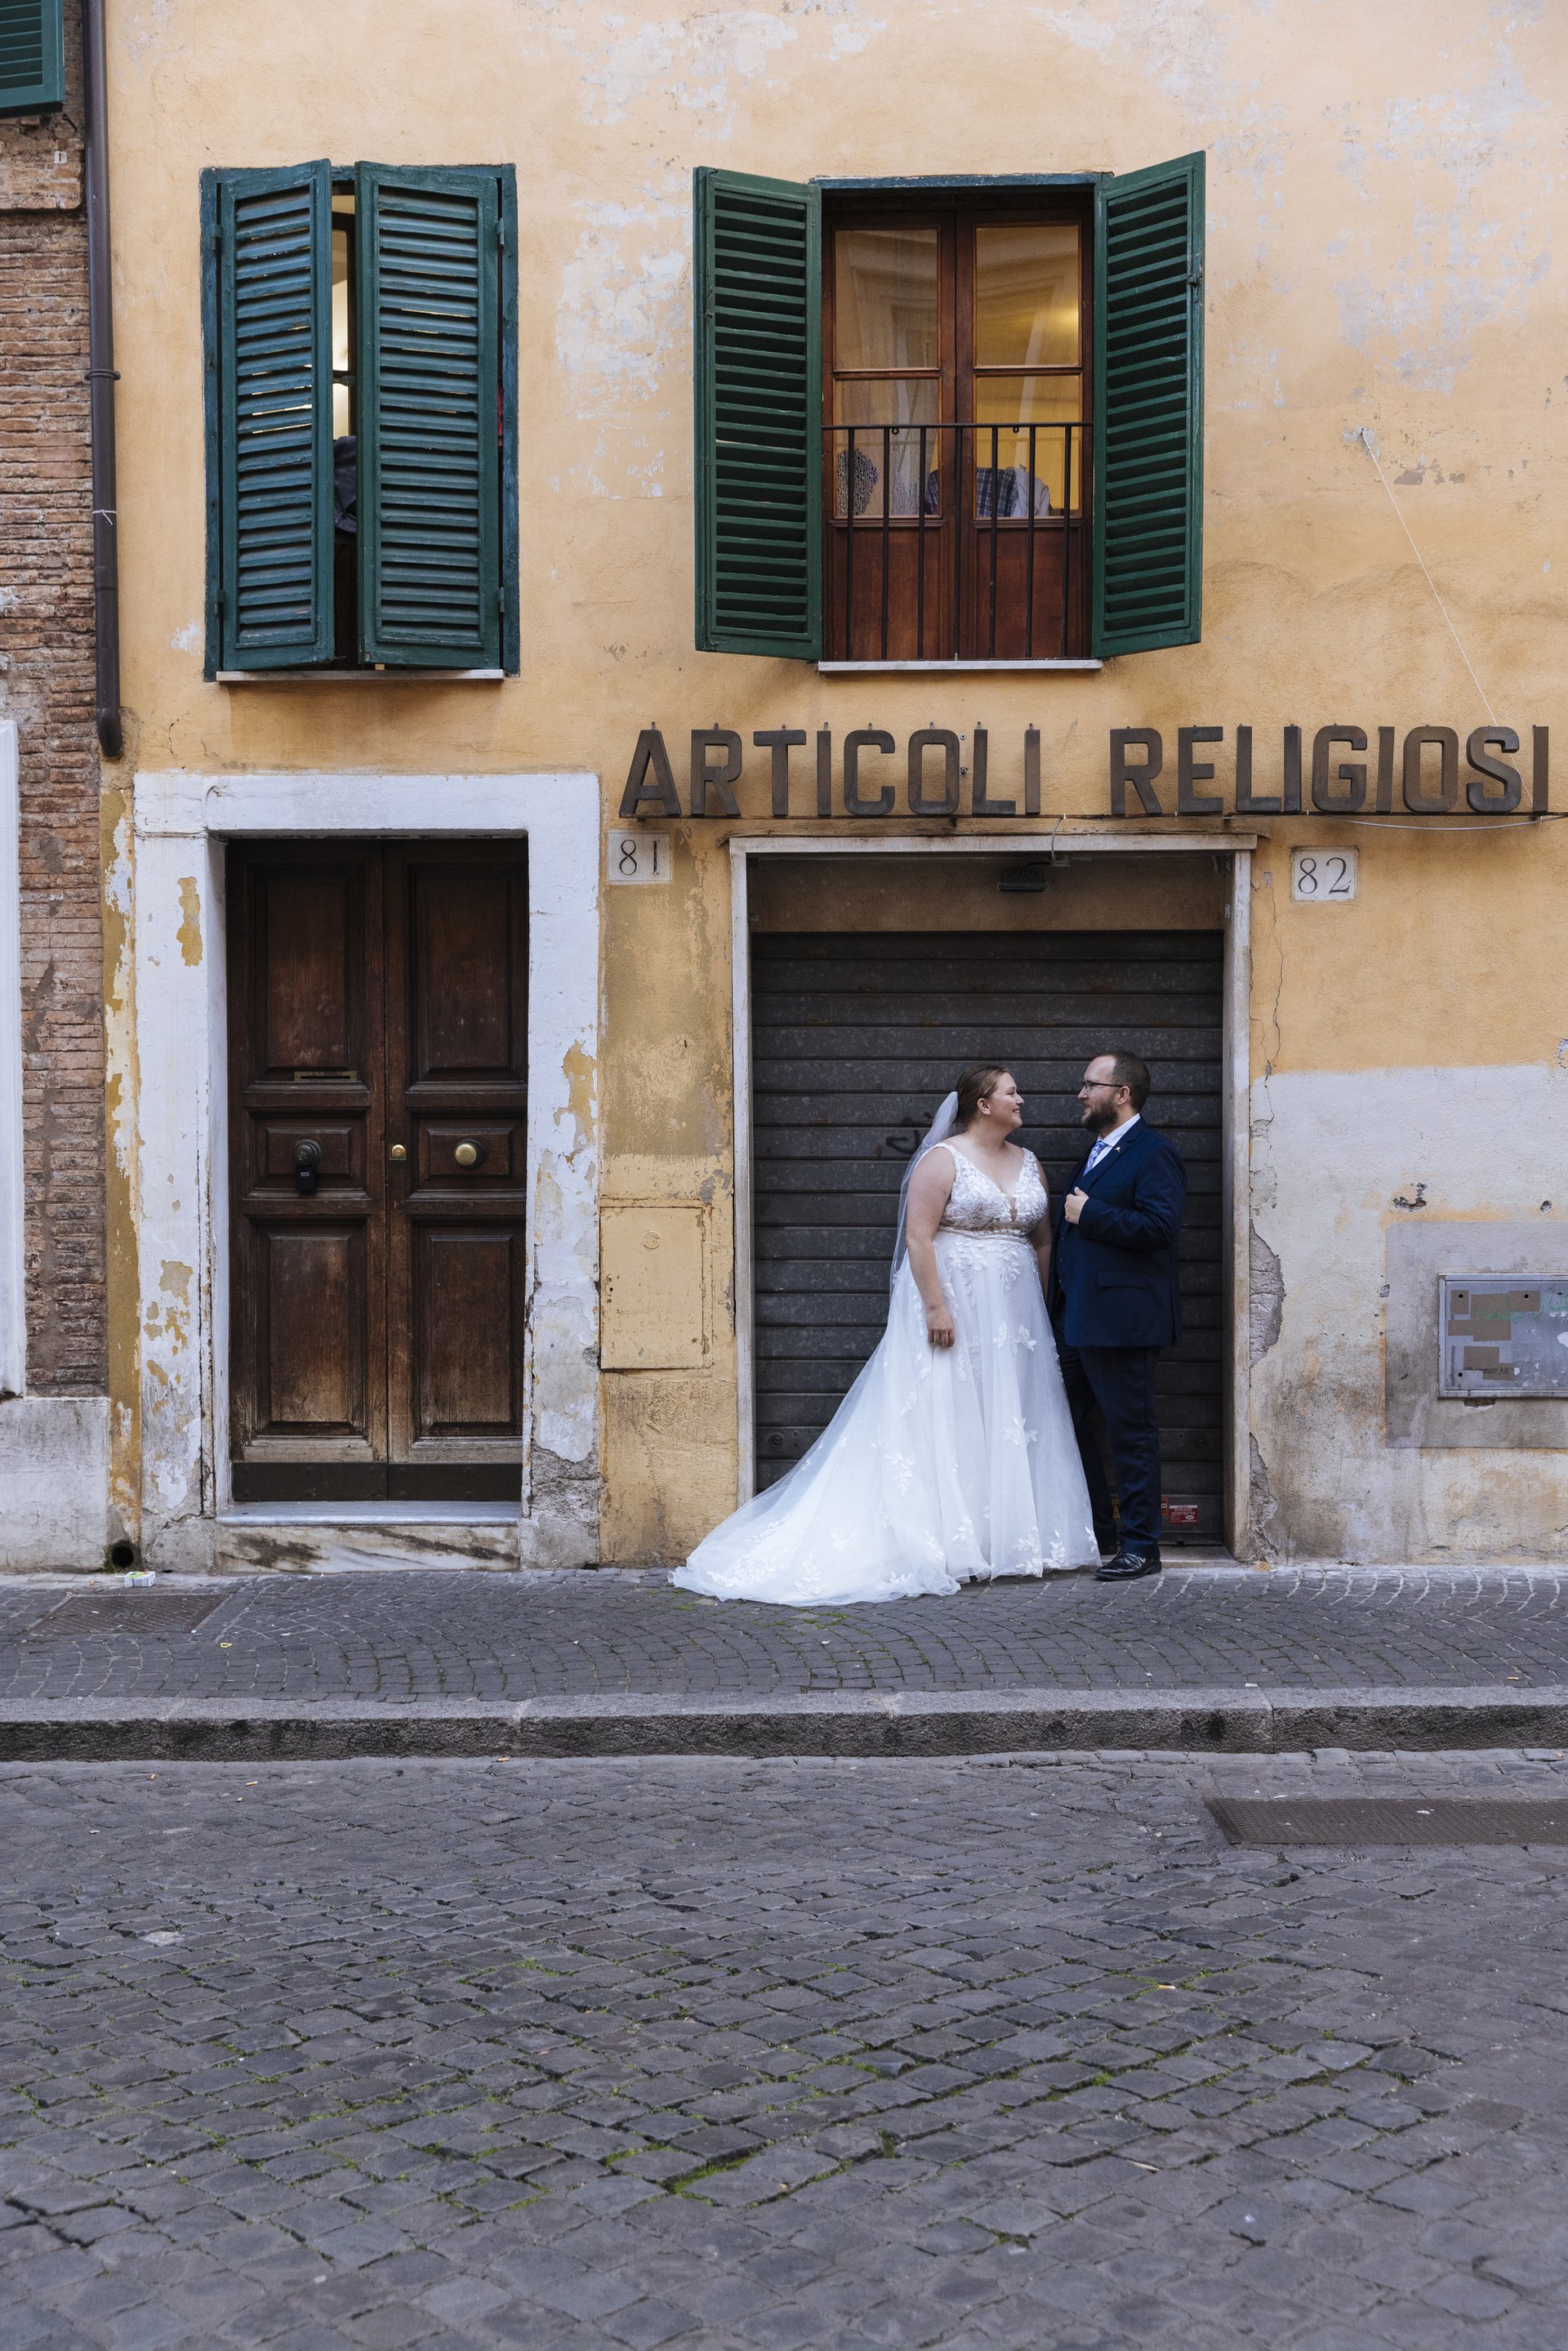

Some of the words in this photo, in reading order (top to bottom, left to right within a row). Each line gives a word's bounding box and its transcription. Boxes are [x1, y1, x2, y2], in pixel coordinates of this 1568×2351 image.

[618, 728, 1041, 817] ARTICOLI
[1110, 725, 1549, 815] RELIGIOSI
[619, 839, 660, 876] 81
[1298, 857, 1351, 894] 82
